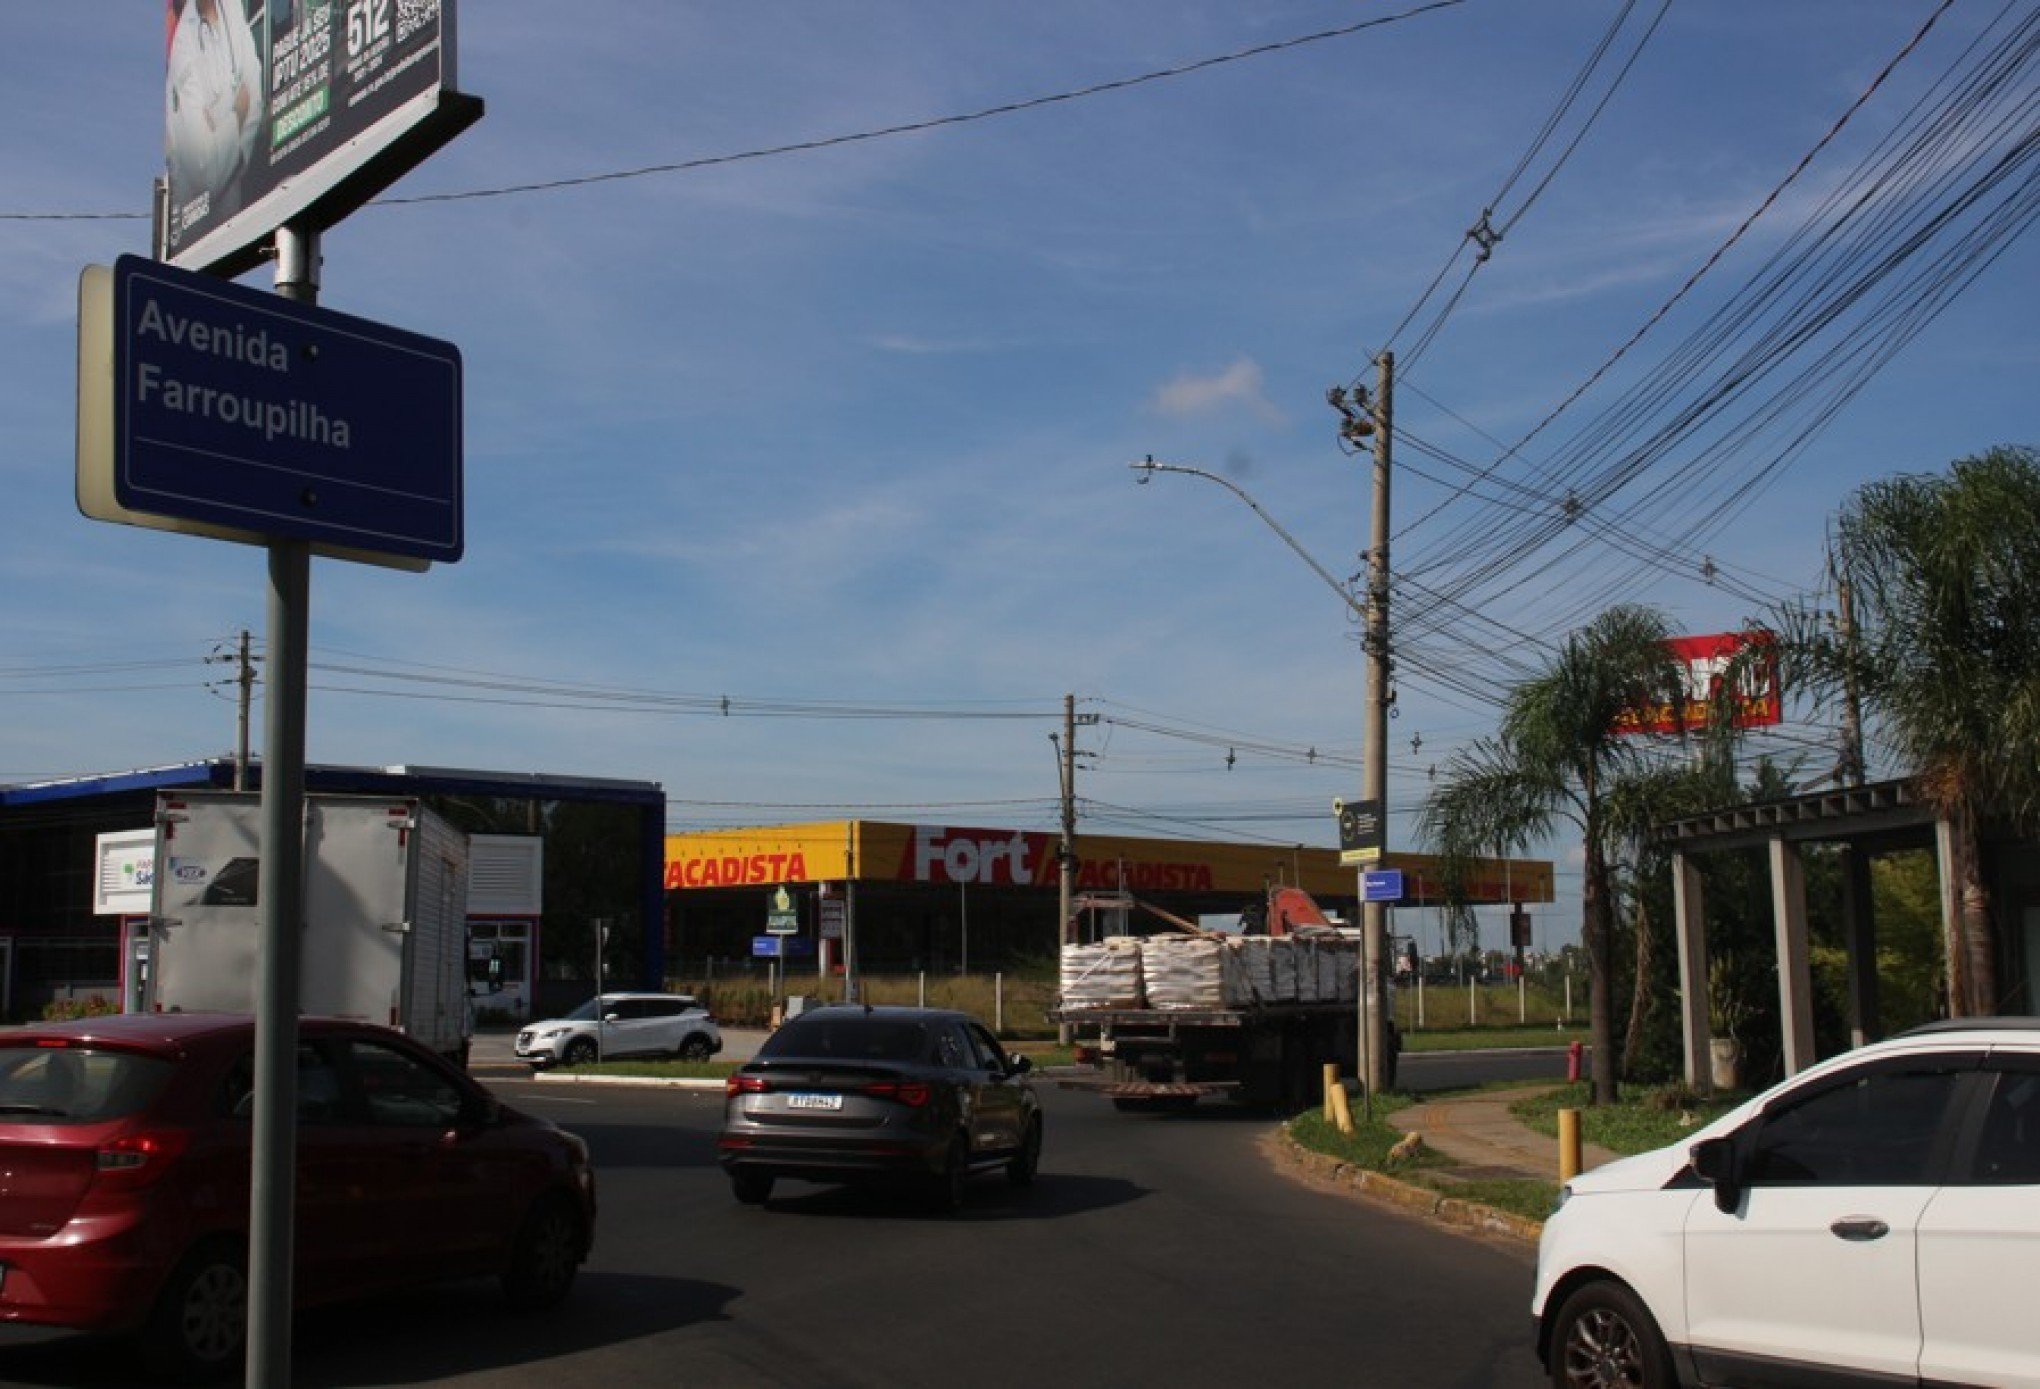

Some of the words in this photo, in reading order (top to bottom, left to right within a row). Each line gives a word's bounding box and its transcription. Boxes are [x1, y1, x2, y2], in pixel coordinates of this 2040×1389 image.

[273, 49, 298, 92] IPTU
[300, 24, 330, 71] 2025
[348, 0, 389, 56] 512
[137, 299, 288, 372] Avenida
[138, 363, 350, 449] Farroupilha
[664, 852, 807, 888] ACADISTA
[914, 825, 1031, 883] Fort
[1046, 857, 1214, 889] AACADISTA
